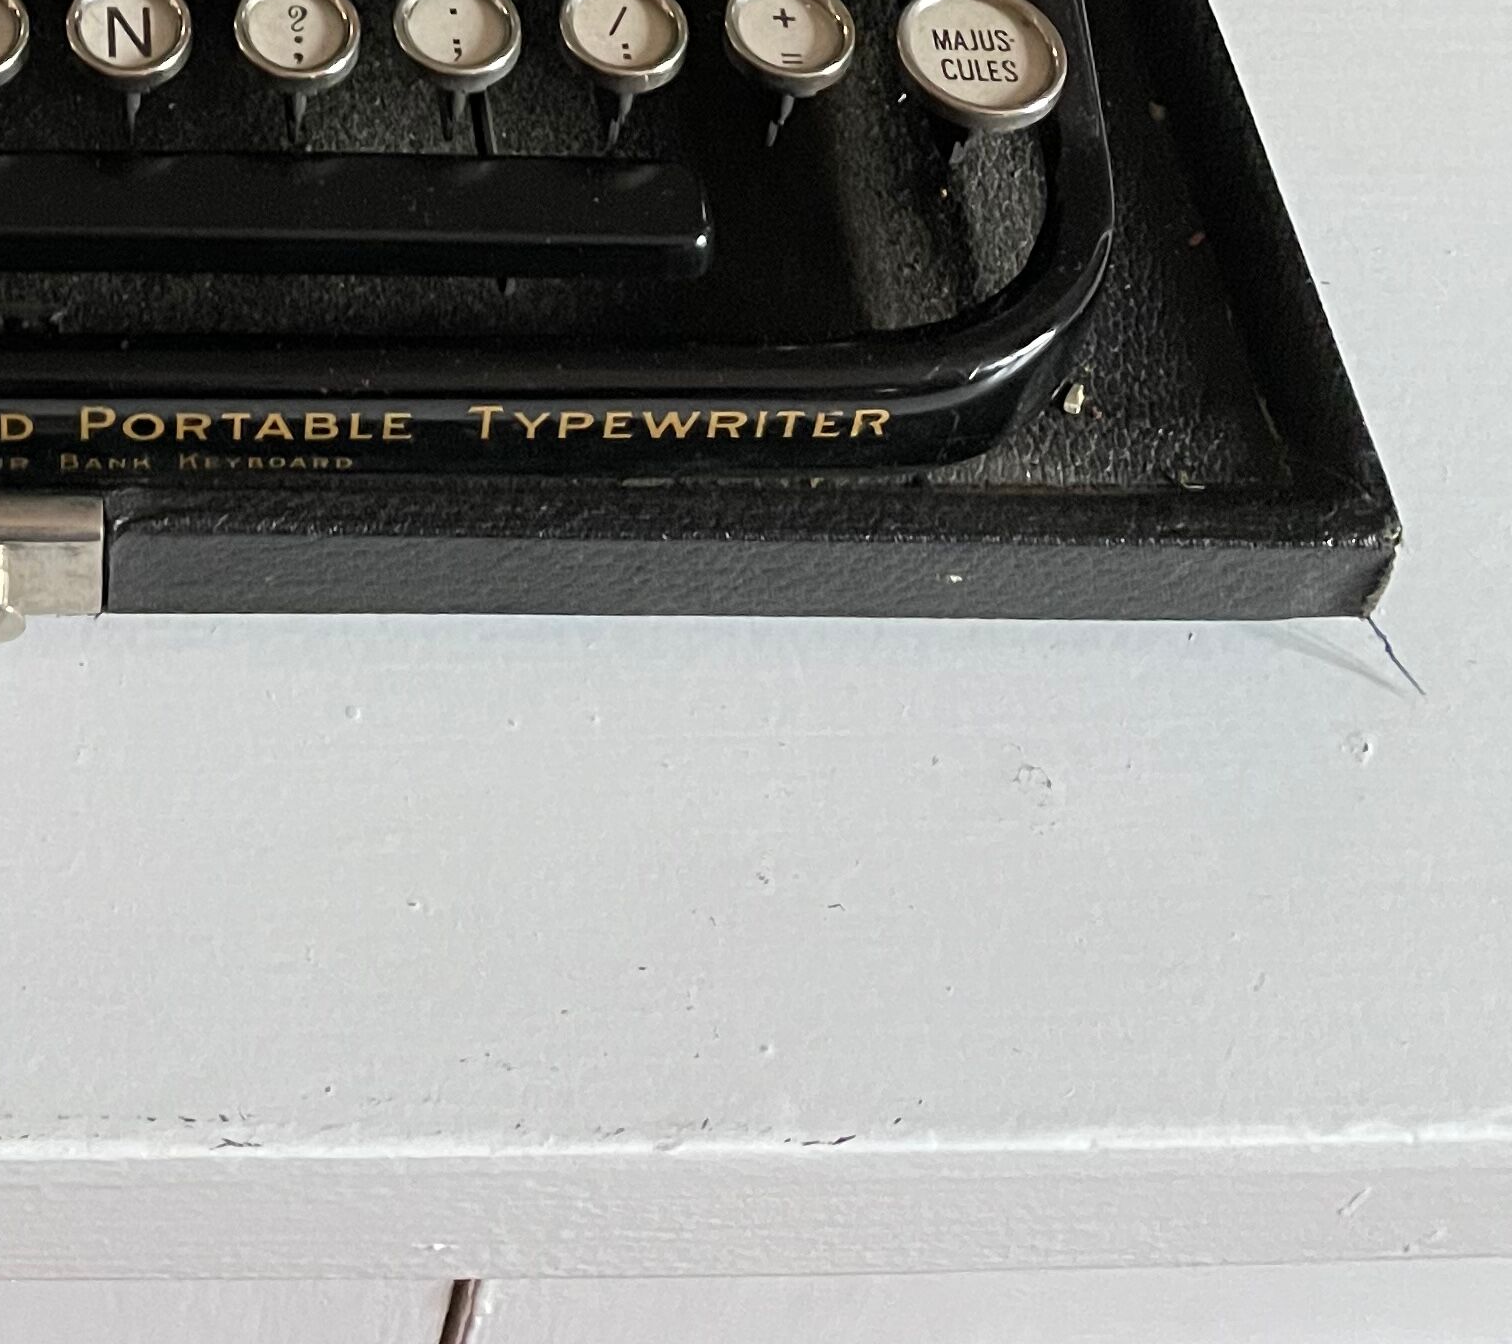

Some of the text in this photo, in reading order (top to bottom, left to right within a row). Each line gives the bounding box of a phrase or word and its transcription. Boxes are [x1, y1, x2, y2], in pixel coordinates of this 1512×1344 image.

[107, 7, 151, 59] N
[932, 29, 1015, 52] MAJUS-
[941, 58, 1019, 82] CULES
[80, 405, 412, 441] PORTABLE
[468, 405, 891, 440] TYPEWRITER
[60, 454, 151, 470] BANK
[179, 453, 354, 470] KEYBOARD
